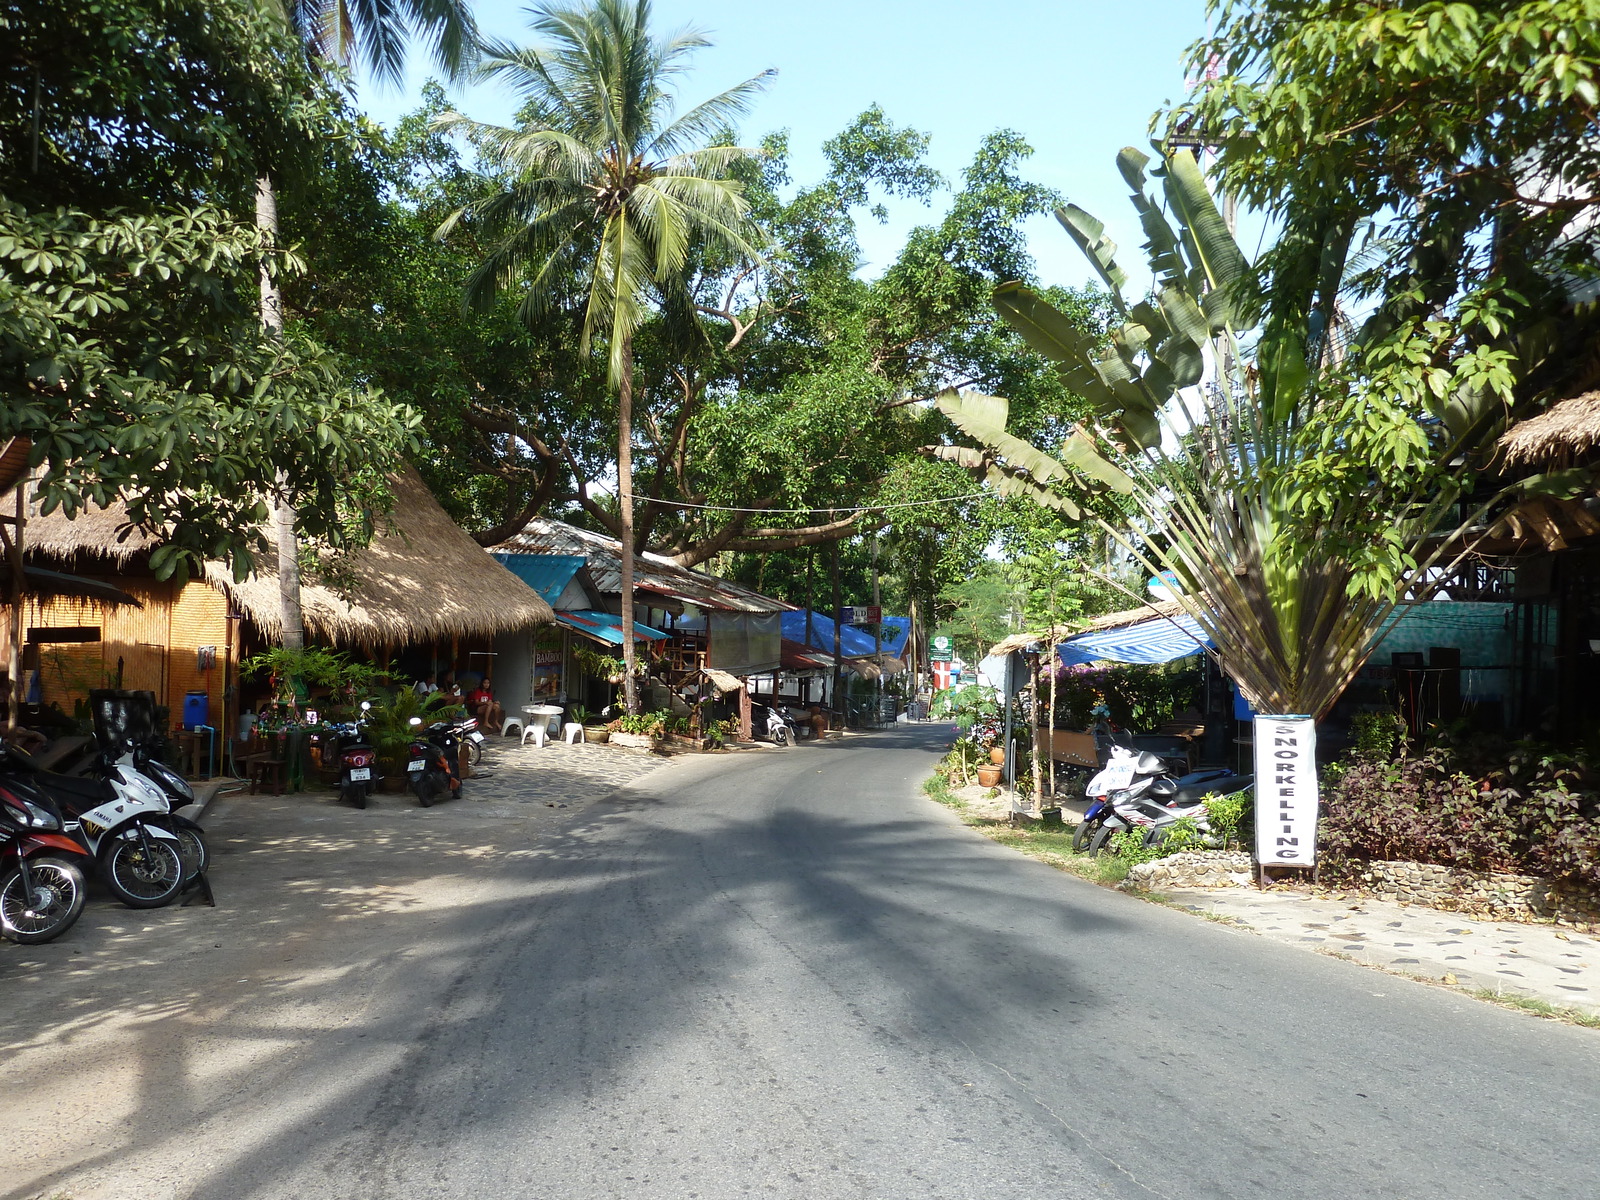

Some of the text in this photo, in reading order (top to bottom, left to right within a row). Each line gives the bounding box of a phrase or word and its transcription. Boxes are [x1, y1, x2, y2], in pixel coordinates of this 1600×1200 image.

[536, 652, 562, 664] BAMBOO
[1274, 726, 1299, 859] SNORKELLING
[93, 811, 112, 824] YAMAHA
